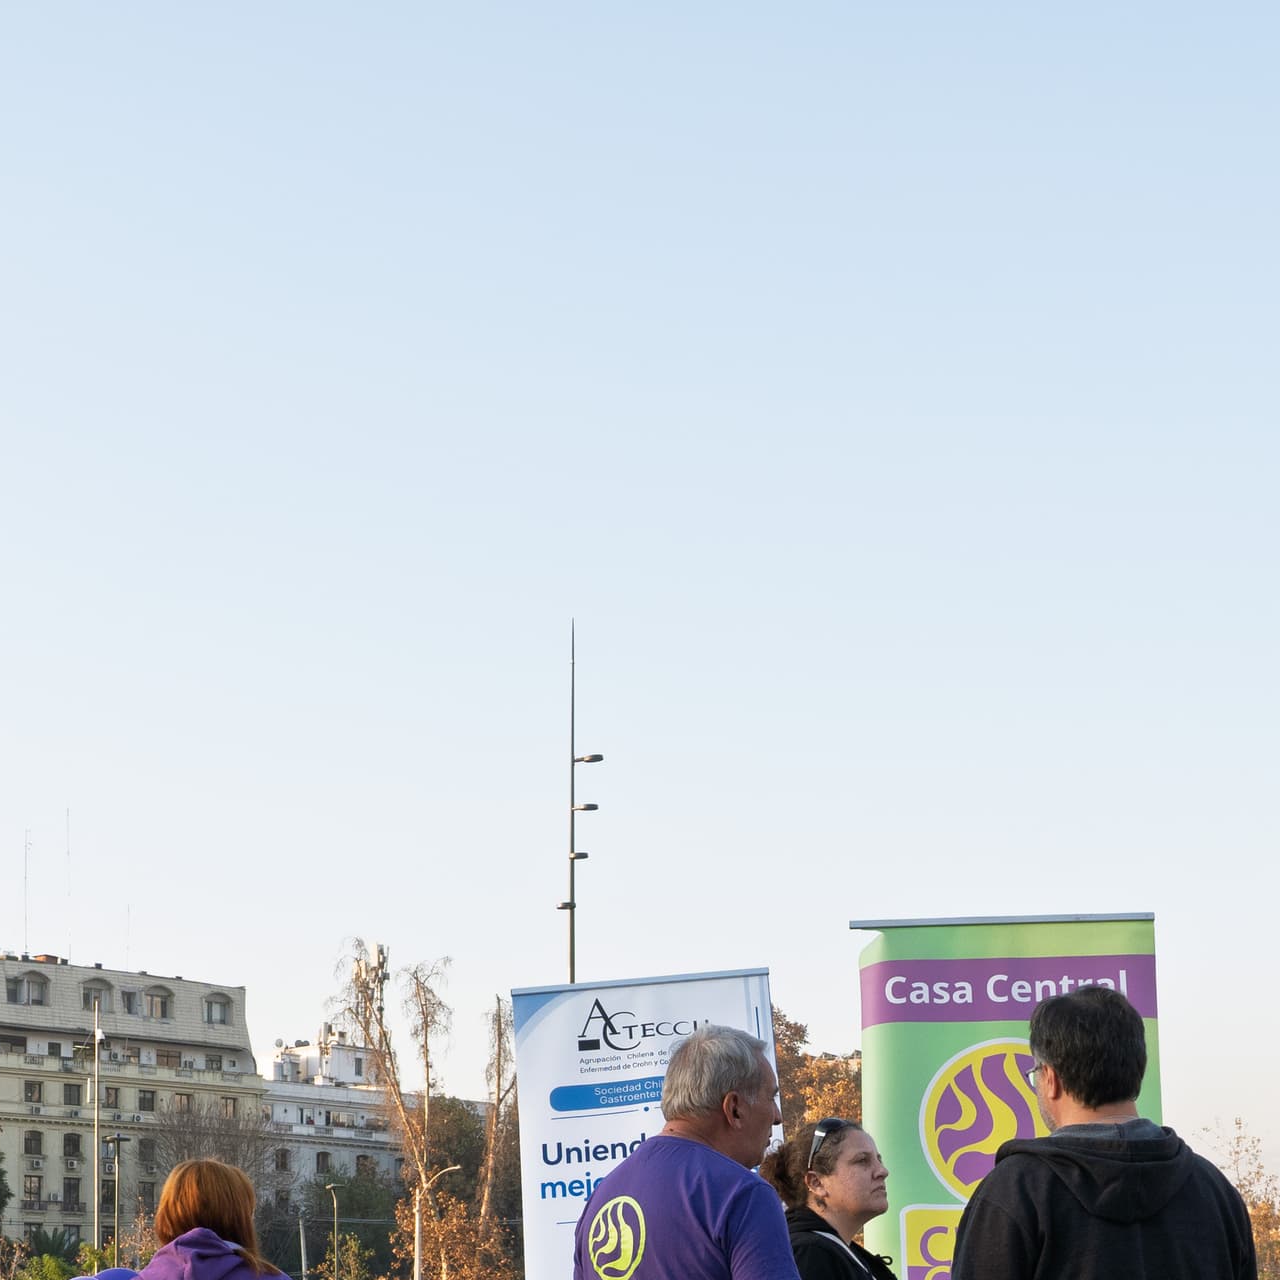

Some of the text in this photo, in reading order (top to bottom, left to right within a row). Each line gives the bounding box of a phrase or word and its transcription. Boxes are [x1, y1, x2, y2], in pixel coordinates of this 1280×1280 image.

[884, 976, 973, 1004] Casa
[579, 1055, 622, 1065] Agrupación
[626, 1050, 654, 1060] Chilena
[579, 1064, 621, 1074] Enfermedad
[622, 1062, 631, 1070] de
[632, 1059, 653, 1068] Crohn
[594, 1082, 642, 1096] Sociedad
